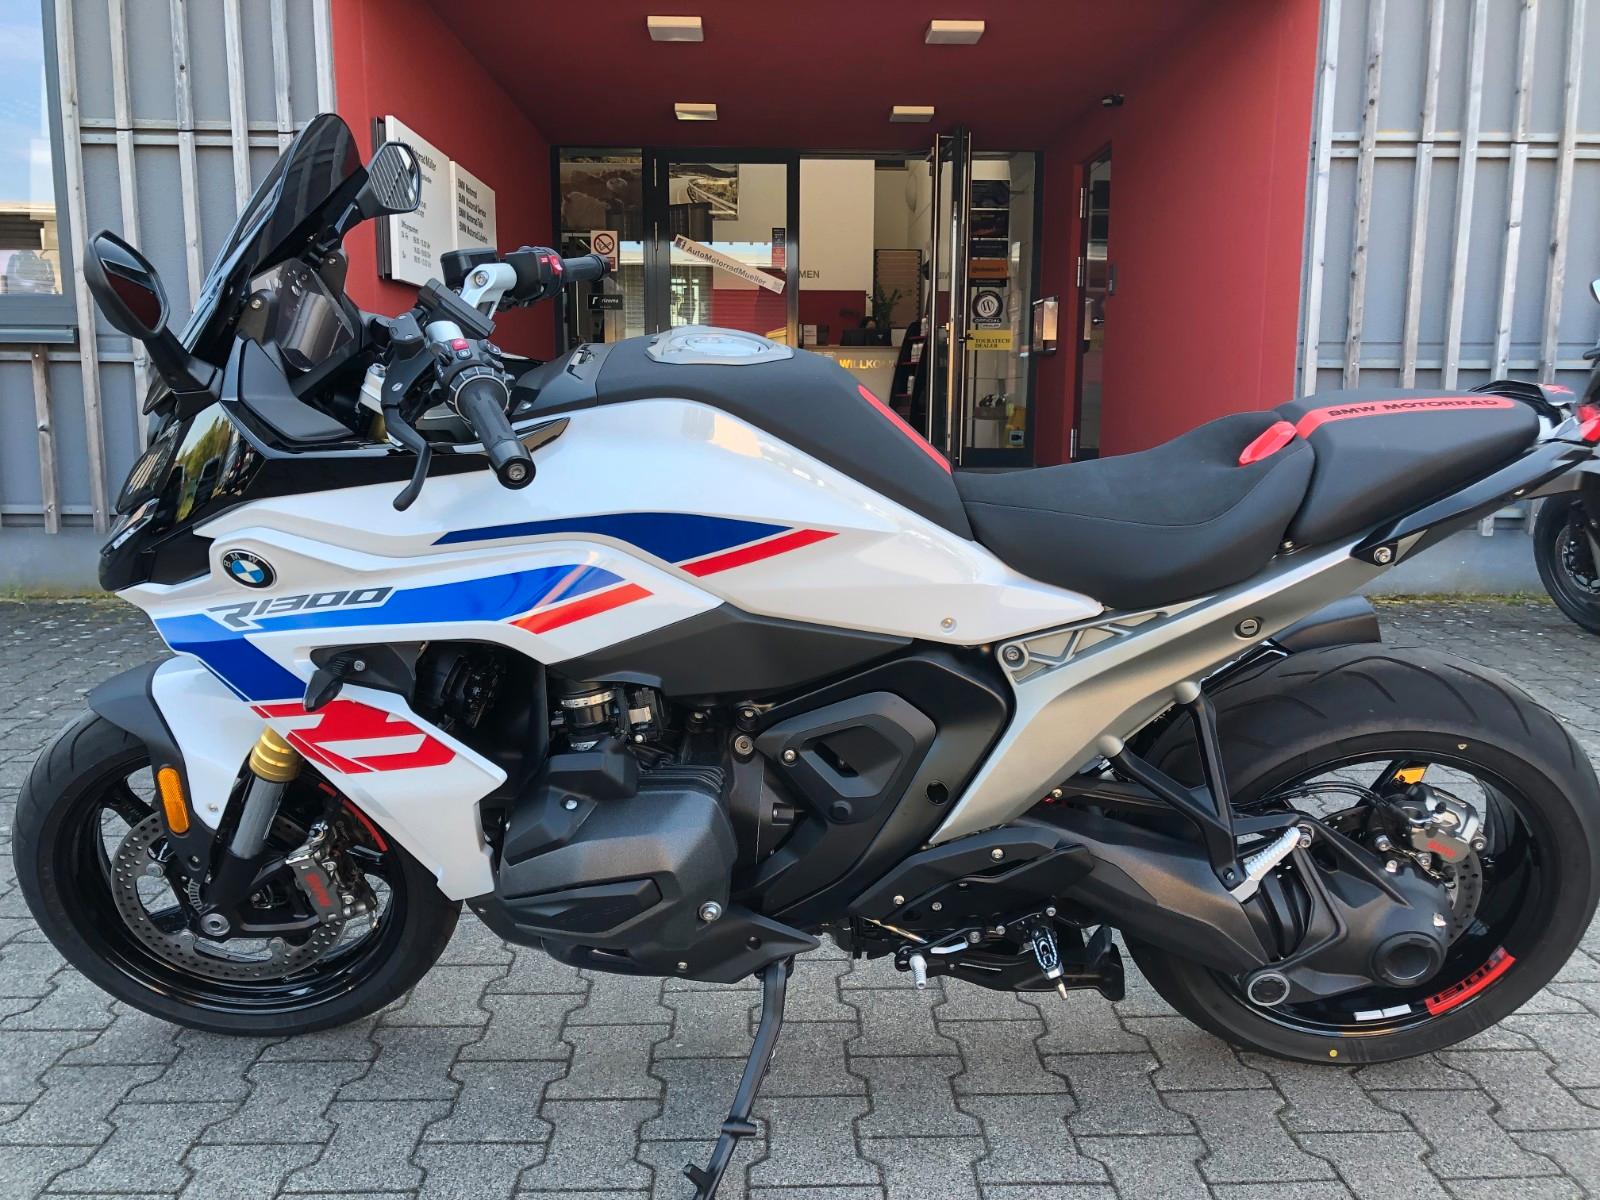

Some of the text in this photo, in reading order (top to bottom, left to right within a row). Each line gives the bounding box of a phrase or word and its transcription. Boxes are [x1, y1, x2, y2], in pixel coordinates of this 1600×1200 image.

[686, 246, 767, 287] AutoMotorradMueller
[1327, 399, 1499, 417] BMW MOTORRAD
[223, 552, 259, 568] BMW
